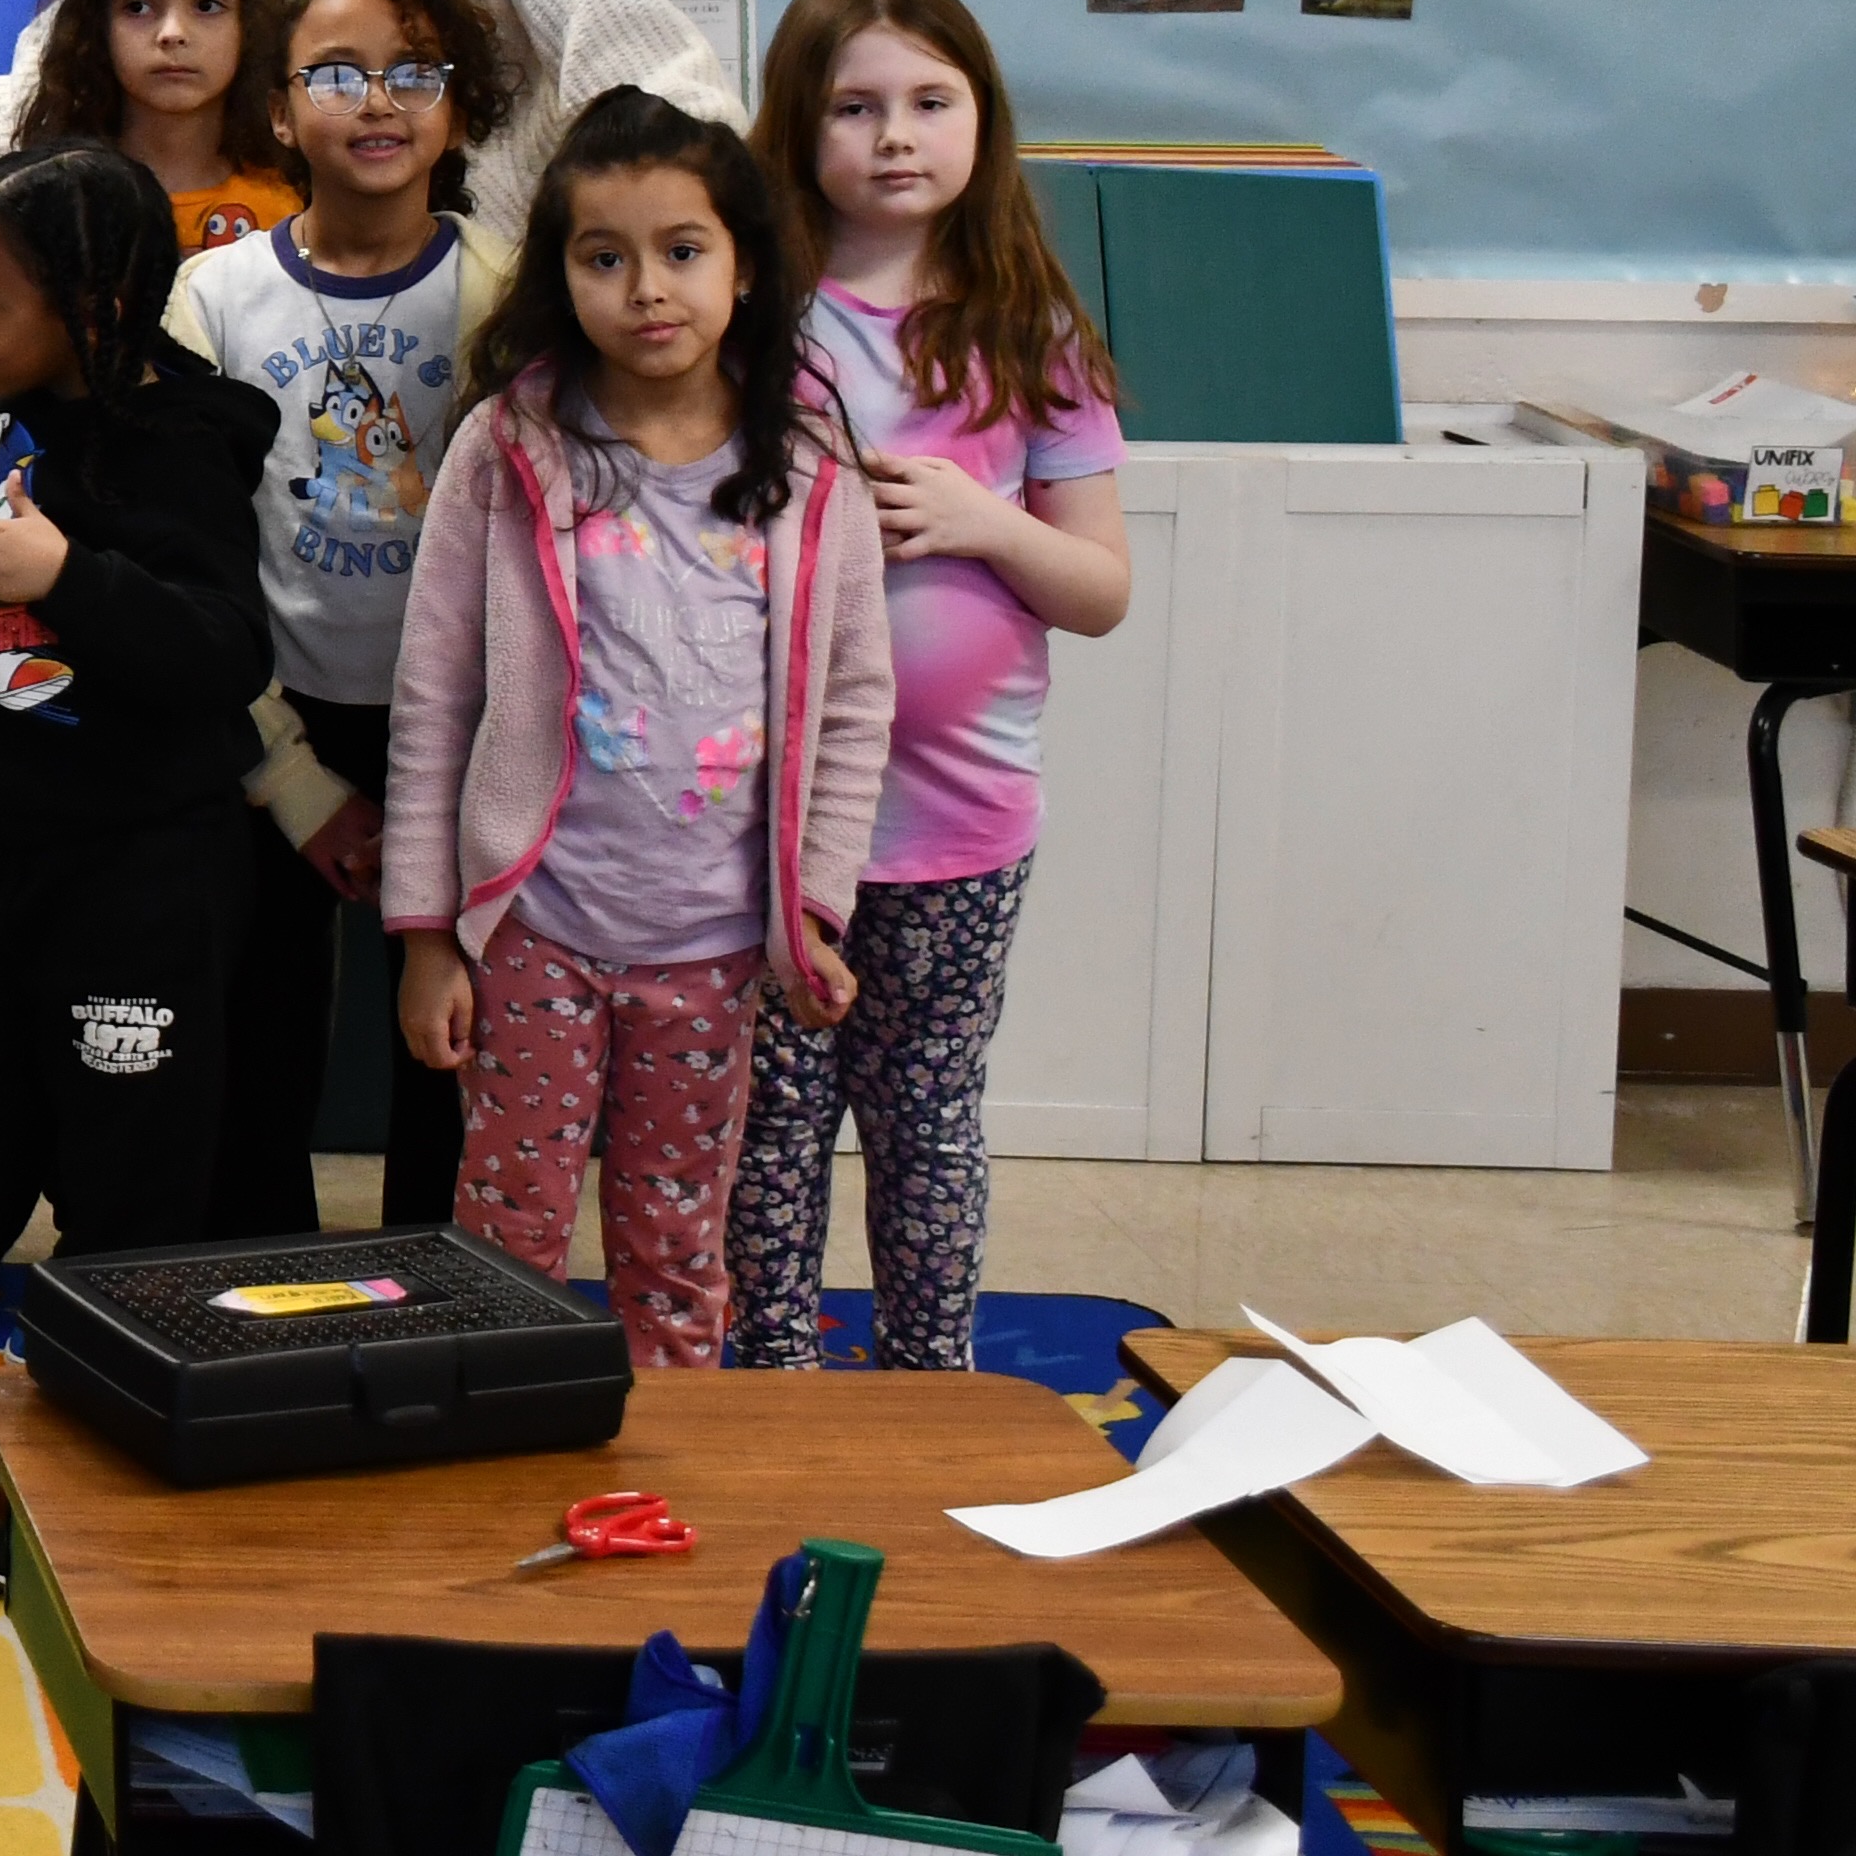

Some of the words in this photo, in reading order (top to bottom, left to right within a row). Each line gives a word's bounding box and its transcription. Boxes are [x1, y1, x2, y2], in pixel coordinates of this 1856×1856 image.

[261, 323, 418, 388] BLUEY
[1754, 449, 1815, 466] UNIFIX
[71, 1005, 174, 1027] BUFFALO
[81, 1054, 158, 1074] REGISTERED
